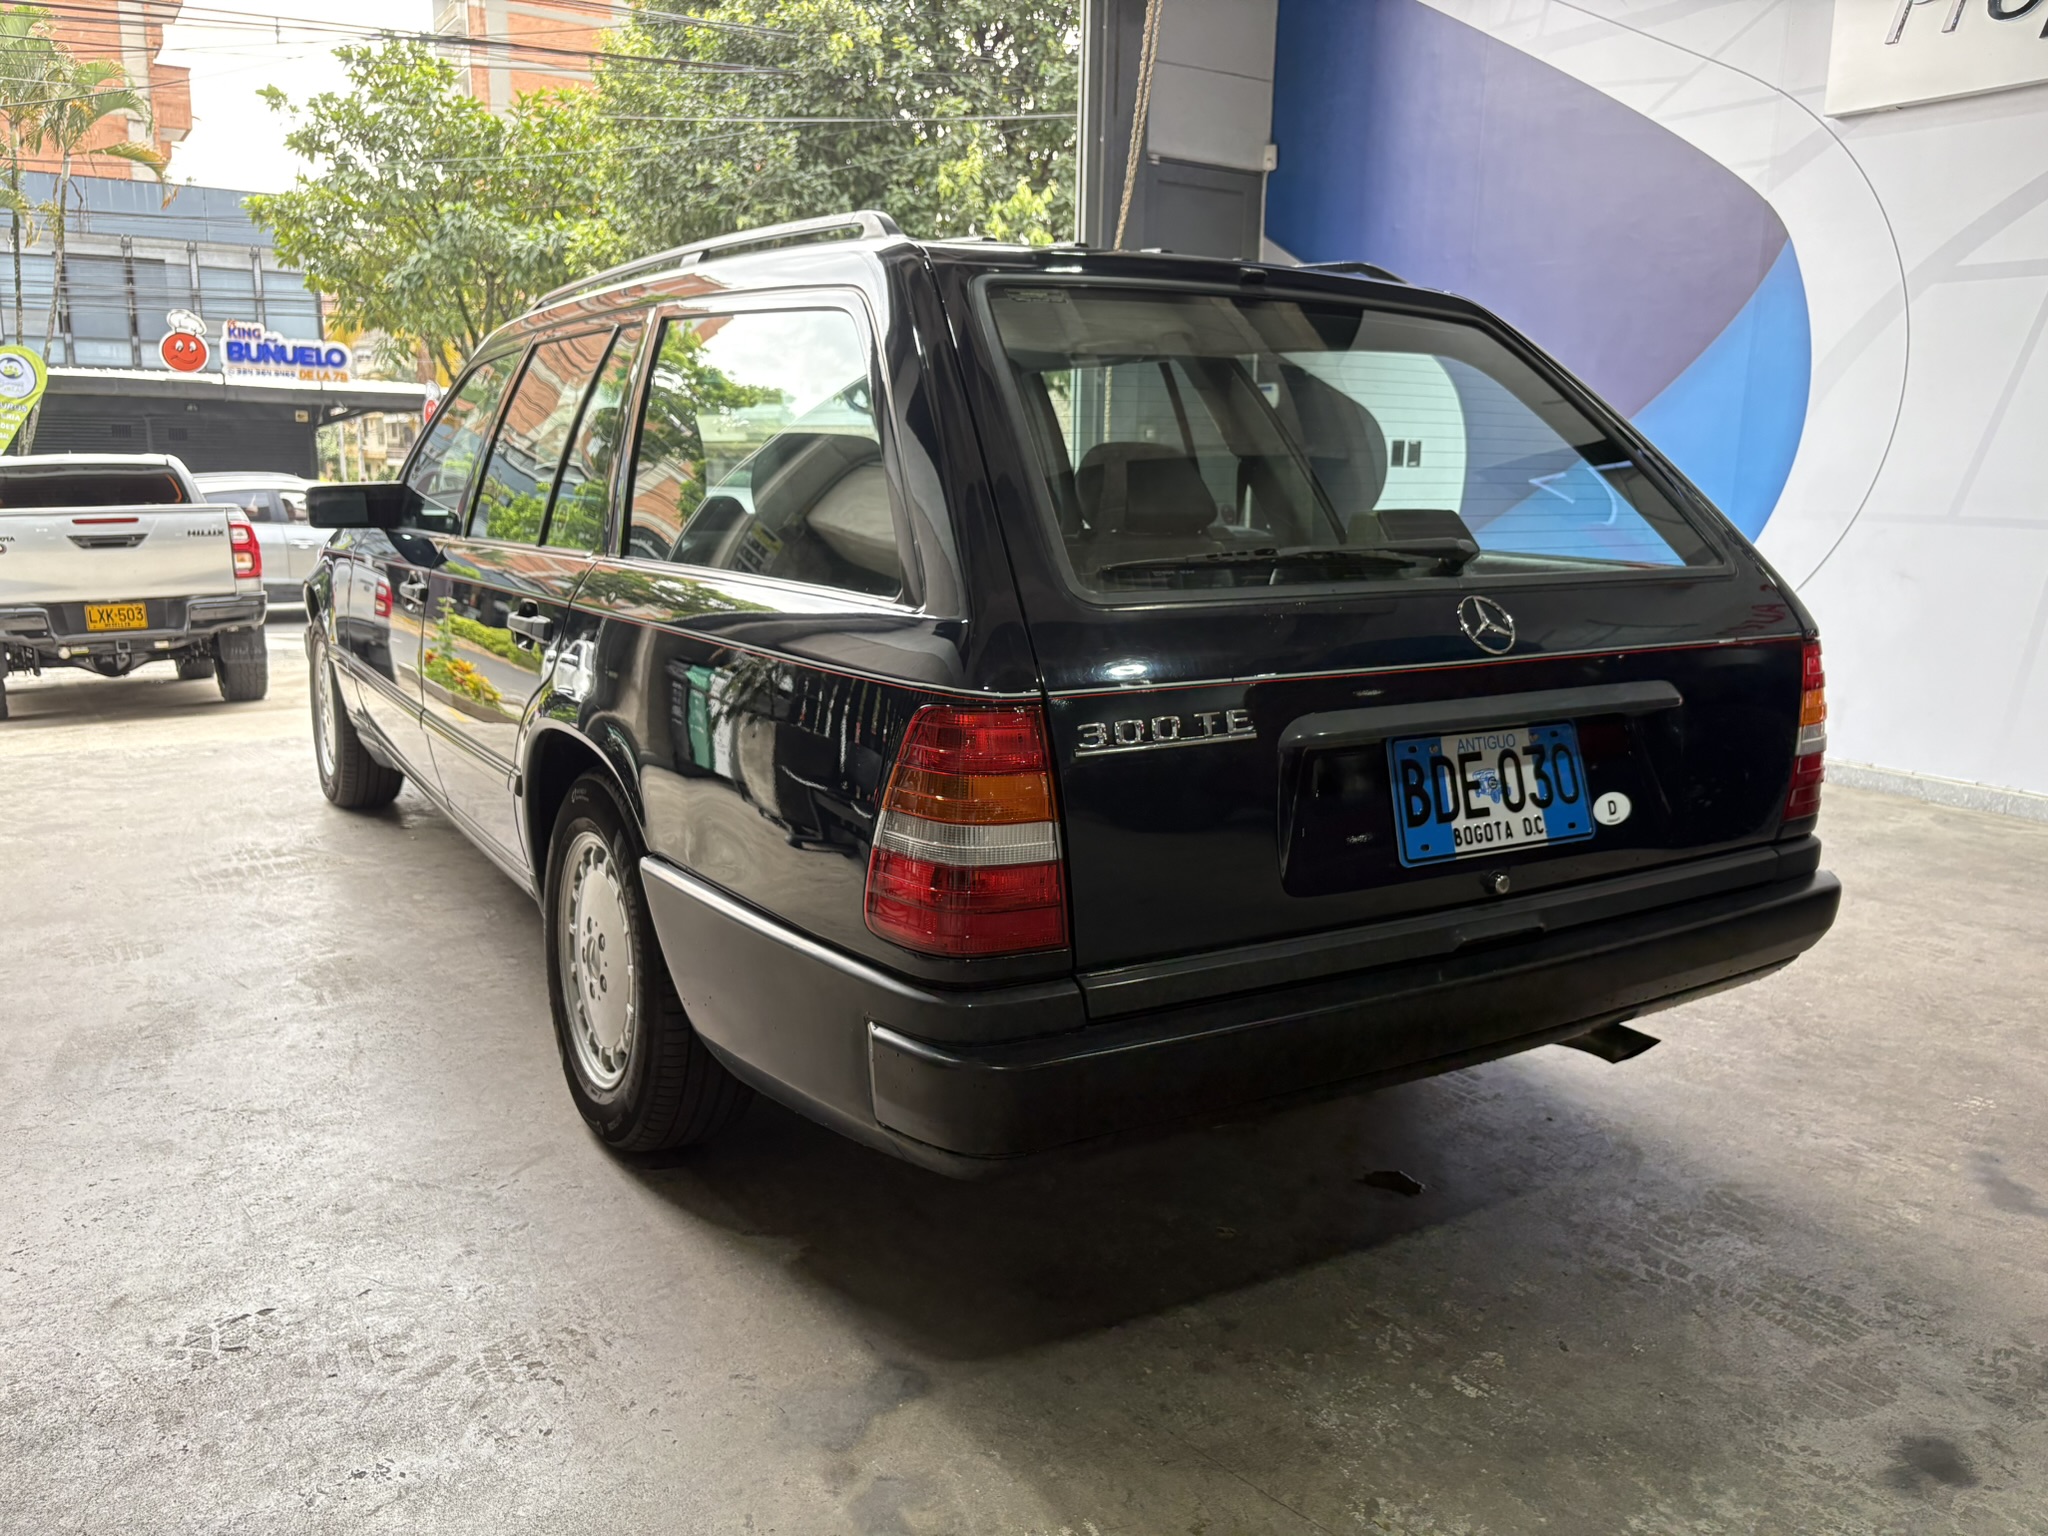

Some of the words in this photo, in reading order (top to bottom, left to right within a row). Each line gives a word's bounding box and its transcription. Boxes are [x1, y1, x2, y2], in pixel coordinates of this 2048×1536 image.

[228, 327, 262, 340] KING
[226, 338, 347, 368] BUÑUELO
[299, 369, 314, 381] DE
[316, 369, 331, 382] LA
[1077, 715, 1181, 749] 300
[1193, 708, 1256, 737] TE
[1458, 733, 1516, 752] ANTIGUO
[1608, 800, 1617, 816] D
[1453, 820, 1513, 847] BOGOTA
